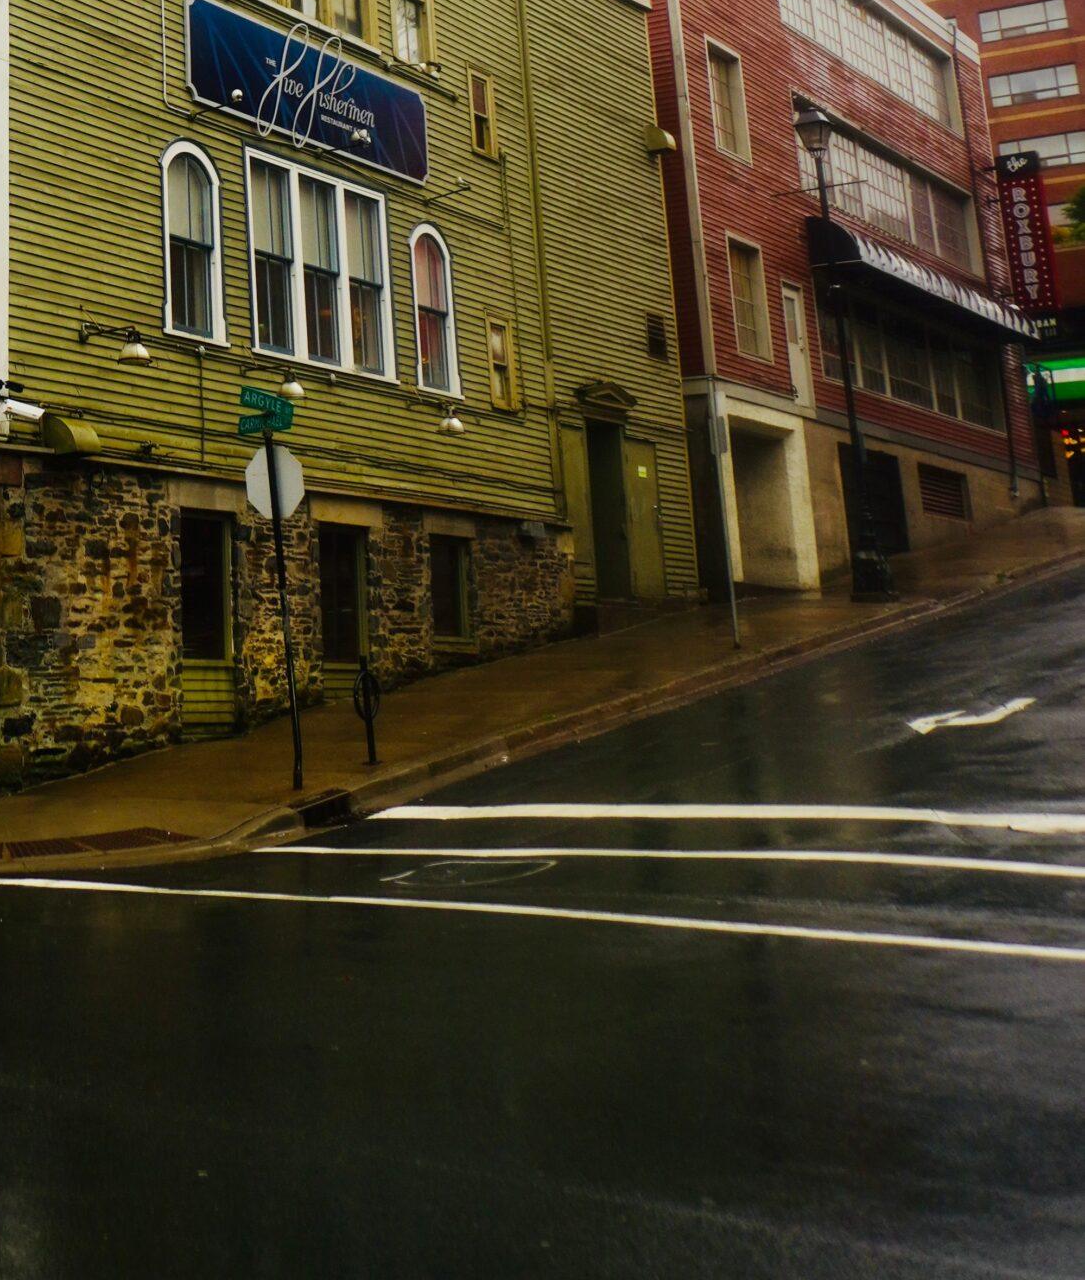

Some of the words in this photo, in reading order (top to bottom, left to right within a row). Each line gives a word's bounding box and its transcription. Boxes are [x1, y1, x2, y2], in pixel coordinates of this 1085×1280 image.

[320, 114, 353, 133] RESTAURANT
[1011, 186, 1040, 301] ROXBURY
[244, 391, 282, 413] ARGYLE
